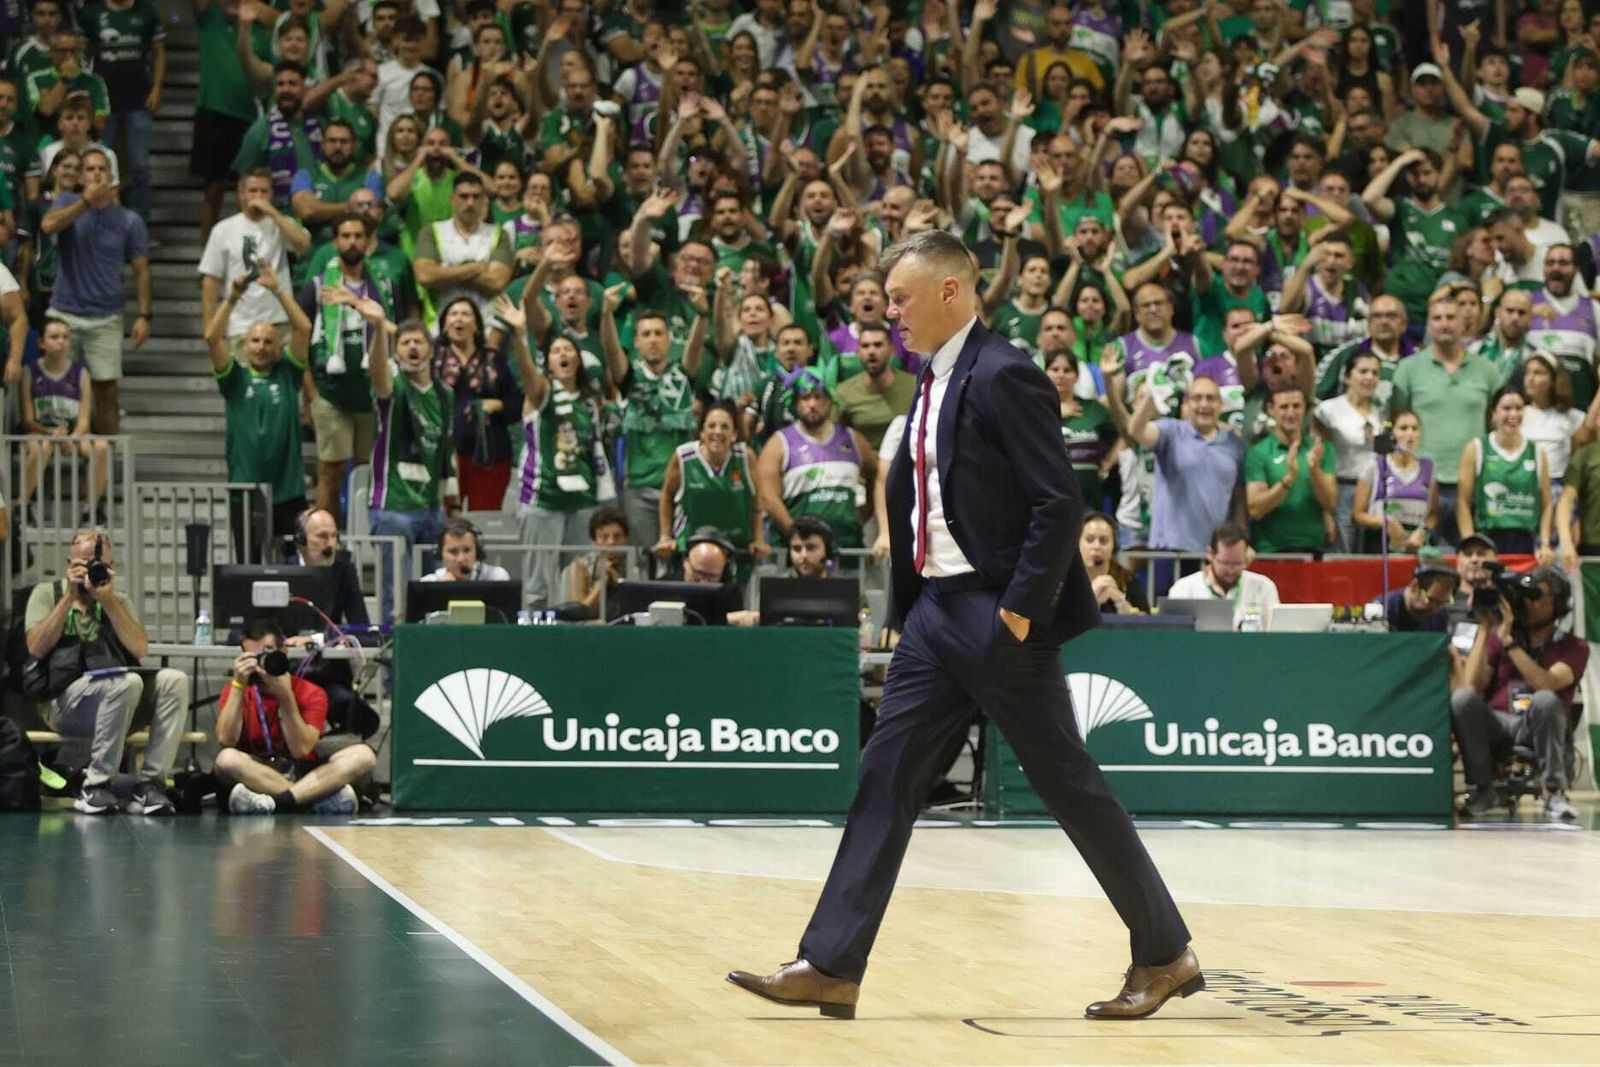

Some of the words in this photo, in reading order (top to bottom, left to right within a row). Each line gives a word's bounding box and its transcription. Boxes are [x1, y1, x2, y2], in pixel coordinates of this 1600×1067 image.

[543, 713, 704, 761] Unicaja
[710, 718, 840, 753] Banco
[1144, 717, 1302, 765] Unicaja
[1307, 723, 1434, 758] Banco
